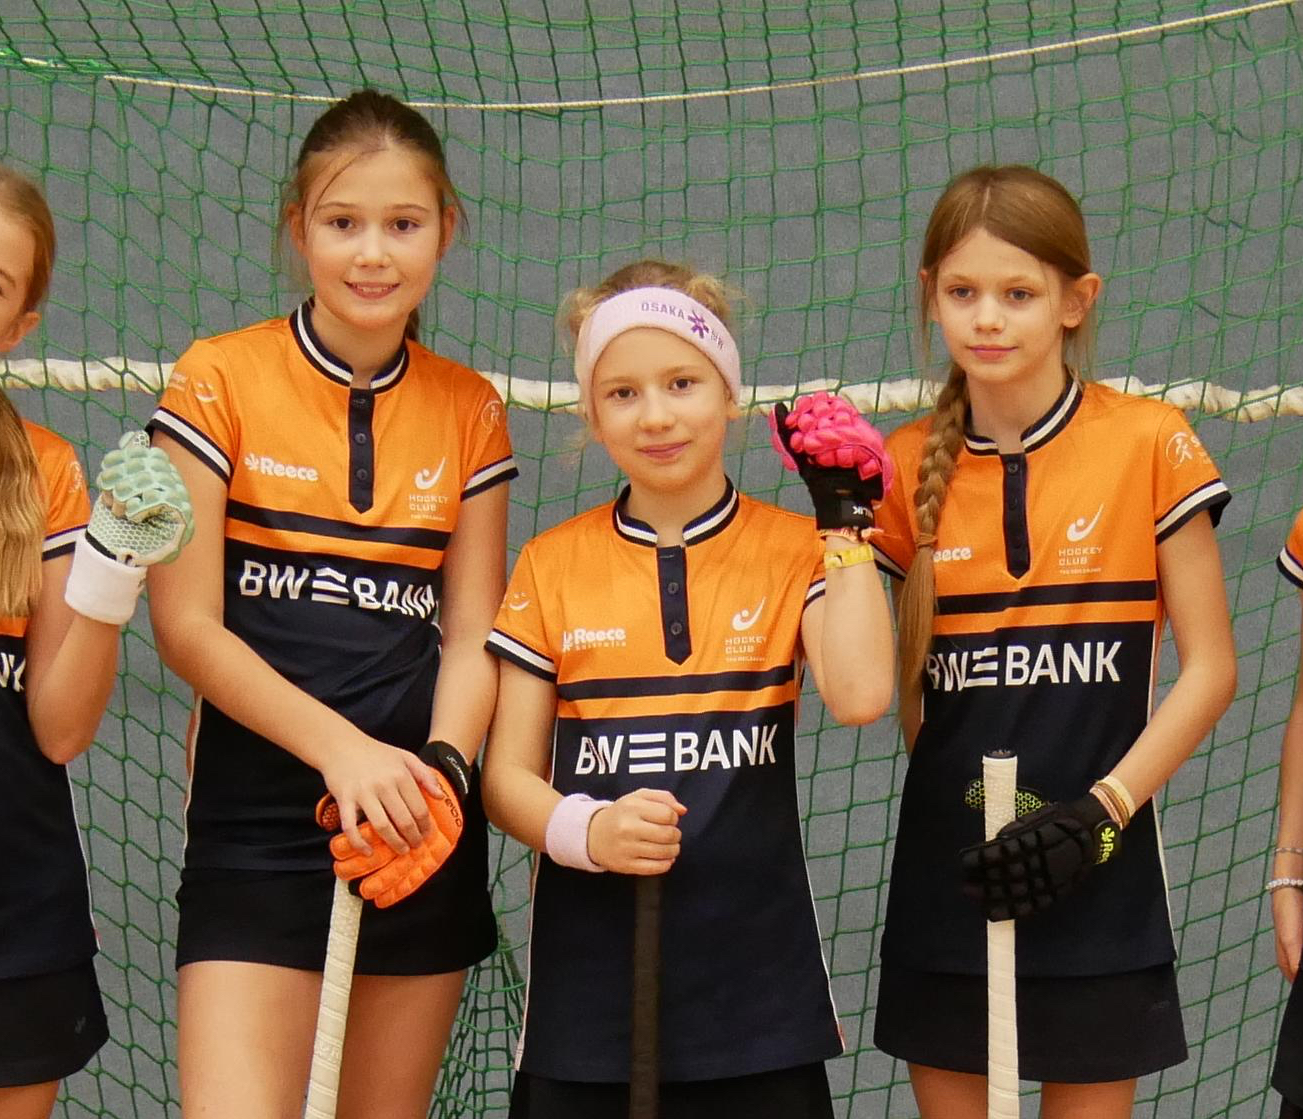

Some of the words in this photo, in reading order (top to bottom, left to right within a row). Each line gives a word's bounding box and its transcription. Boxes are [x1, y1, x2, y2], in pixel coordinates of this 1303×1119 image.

[641, 302, 685, 320] OSAKA
[260, 457, 319, 482] Reece
[1059, 547, 1103, 557] HOCKEY
[1059, 557, 1088, 566] CLUB
[239, 560, 309, 599] BW
[574, 628, 627, 645] Reece
[725, 636, 767, 646] HOCKEY
[725, 645, 755, 654] CLUB
[1005, 641, 1122, 686] BANK
[674, 723, 776, 772] BANK
